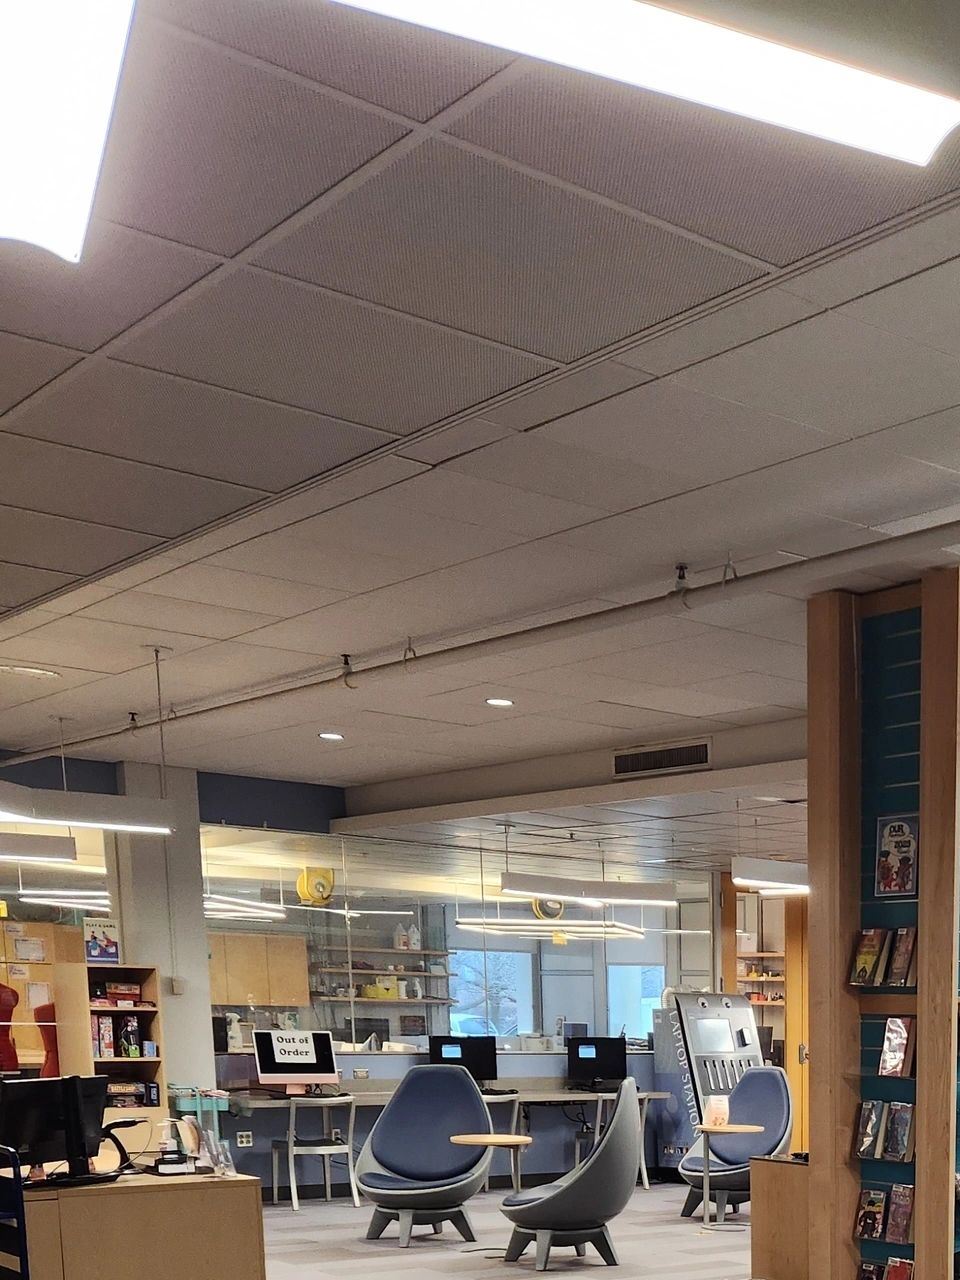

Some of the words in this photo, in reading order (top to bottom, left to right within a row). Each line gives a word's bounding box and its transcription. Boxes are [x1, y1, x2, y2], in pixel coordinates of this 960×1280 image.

[276, 1035, 296, 1044] Out
[298, 1036, 309, 1044] of
[279, 1048, 310, 1056] Order
[669, 1010, 688, 1070] LAPTOP
[682, 1074, 702, 1138] STATION
